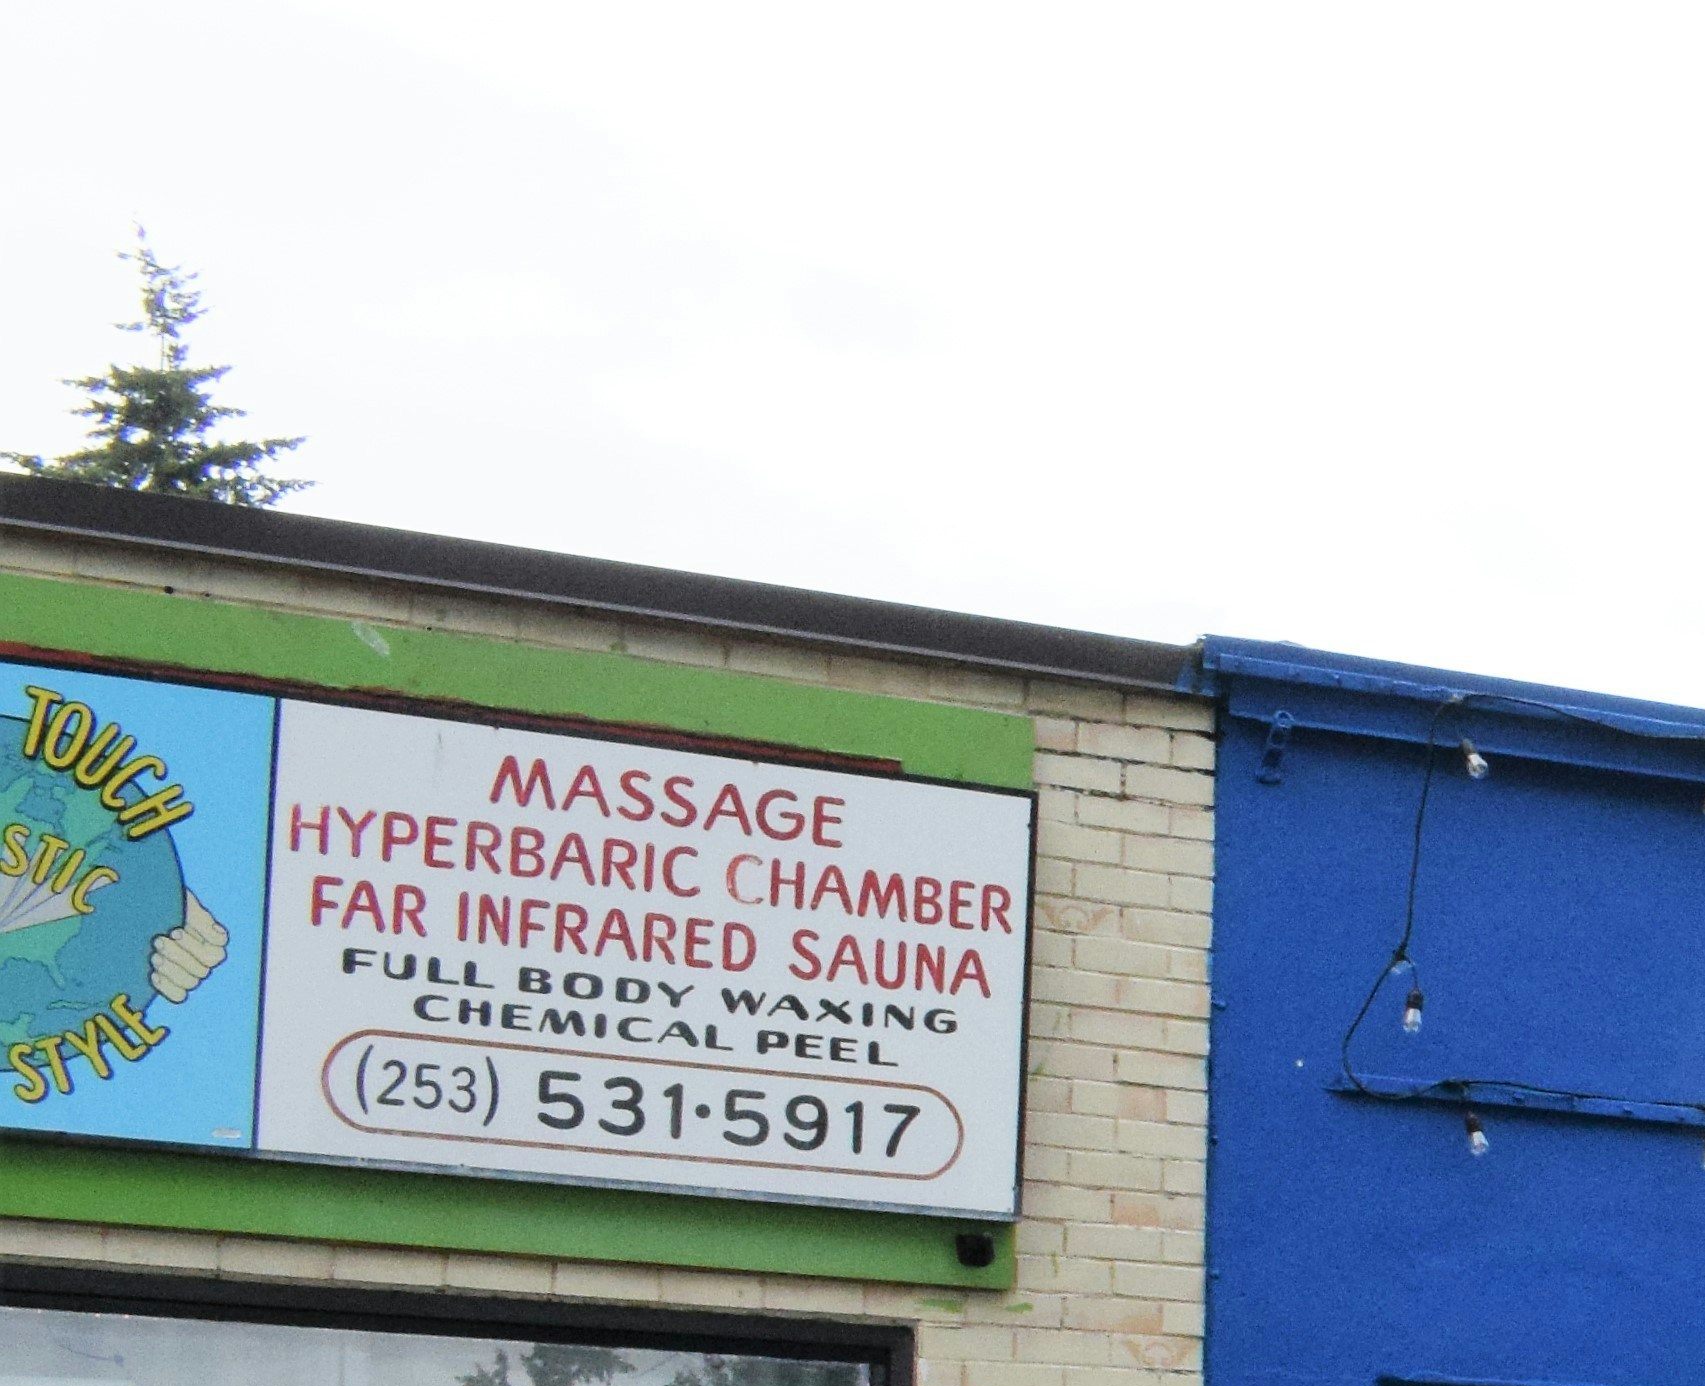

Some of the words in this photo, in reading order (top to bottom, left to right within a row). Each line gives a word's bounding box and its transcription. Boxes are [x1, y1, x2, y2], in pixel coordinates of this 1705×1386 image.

[23, 684, 196, 843] TOUCH
[488, 754, 846, 848] MASSAGE
[289, 803, 701, 898] HYPERBARIC
[725, 853, 1013, 934] CHAMBER
[310, 874, 428, 938] FAR
[456, 890, 758, 973] INFRARED
[787, 928, 992, 999] SAUNA
[341, 947, 496, 990] FULL
[517, 965, 695, 1008] BODY
[720, 986, 959, 1035] WAXING
[412, 993, 735, 1052] CHEMICAL
[756, 1028, 900, 1068] PEEL
[8, 992, 170, 1104] STYLE
[355, 1043, 501, 1127] (253)
